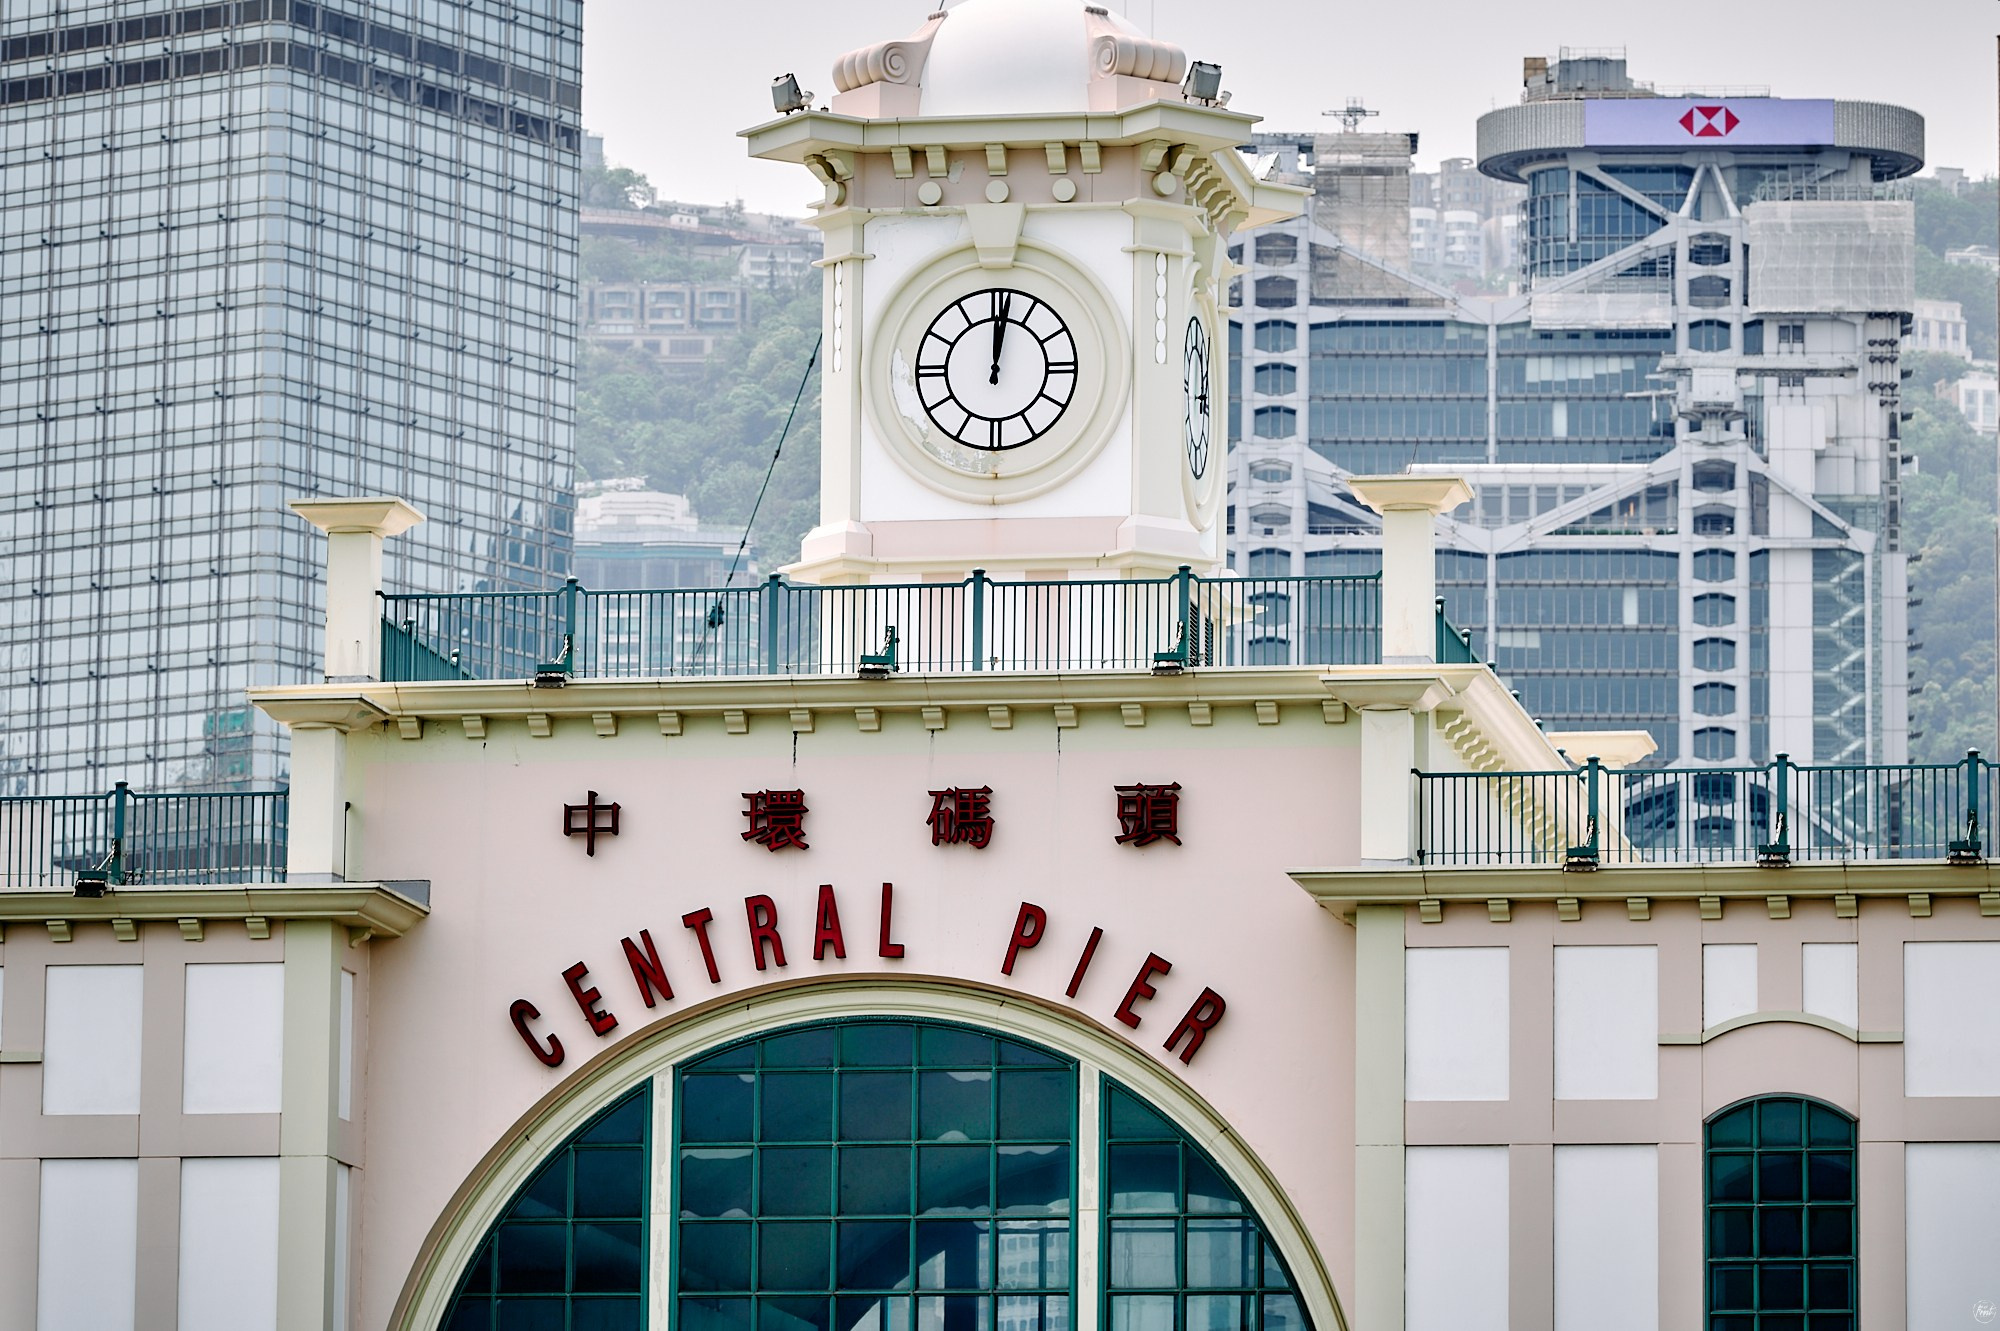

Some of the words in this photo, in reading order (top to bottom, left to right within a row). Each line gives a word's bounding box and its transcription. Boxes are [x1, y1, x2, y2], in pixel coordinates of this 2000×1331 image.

[562, 781, 1183, 858] 中環碼頭
[509, 882, 905, 1068] CENTRAL
[1001, 902, 1227, 1067] PIER
